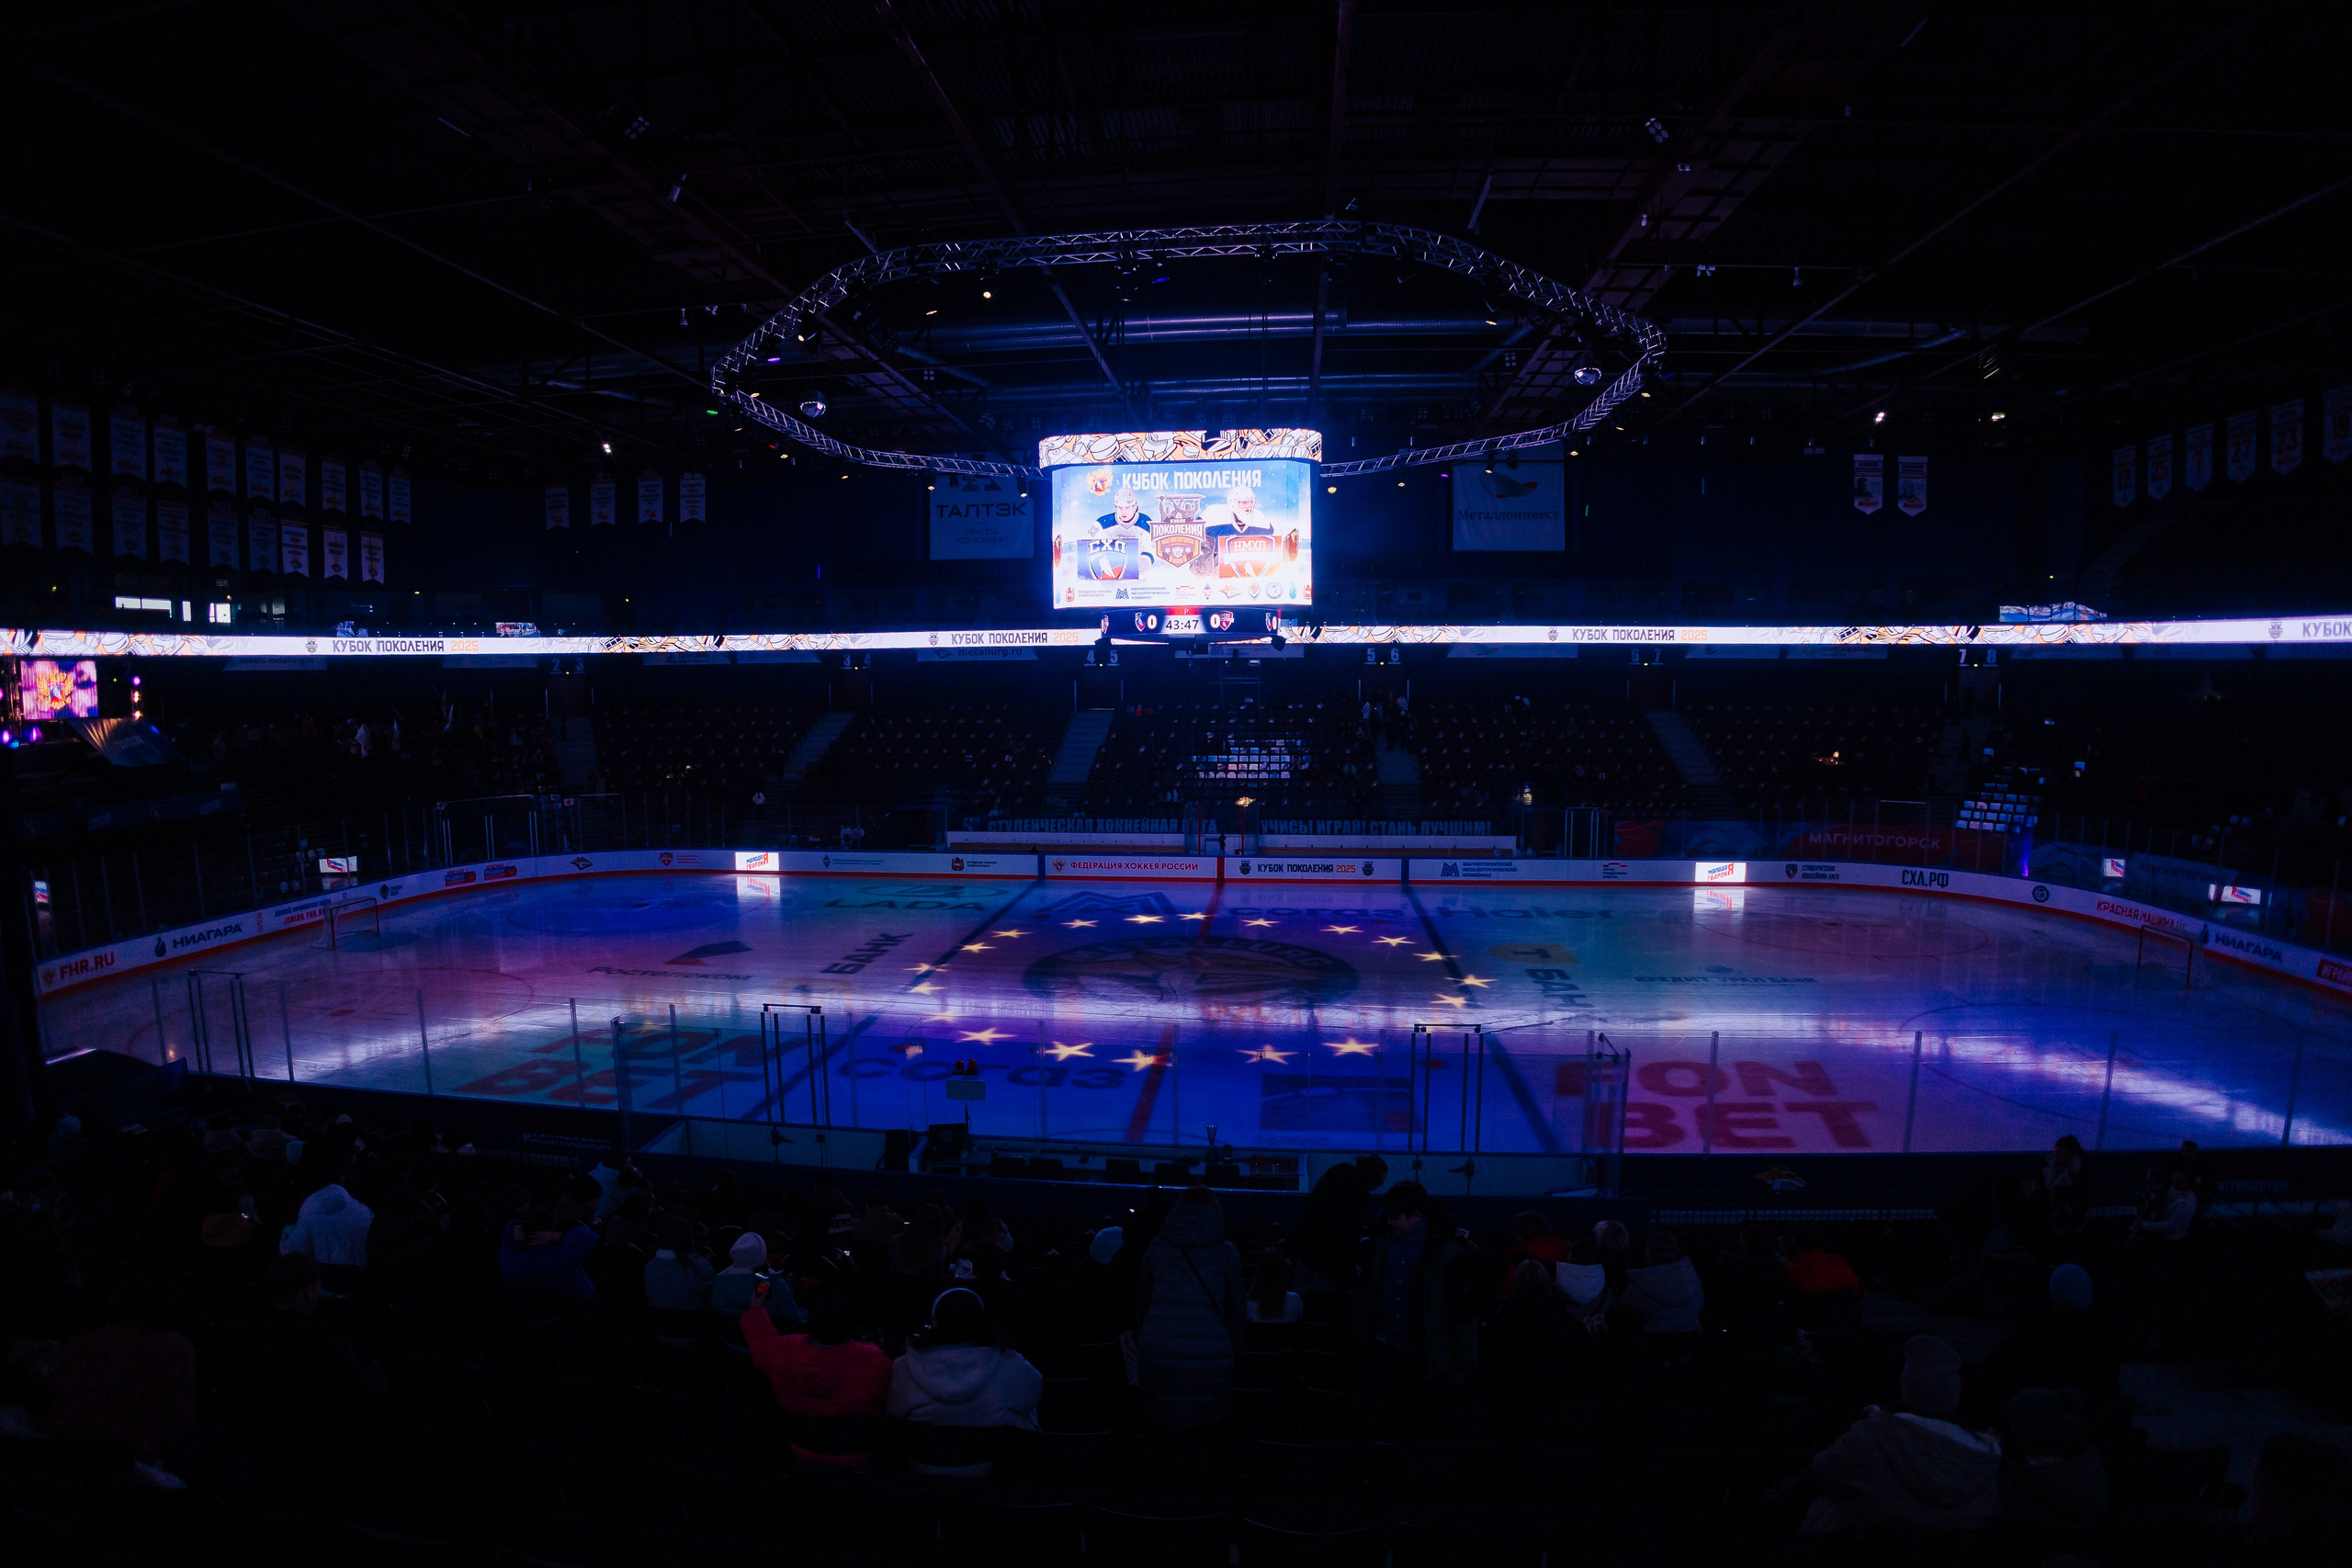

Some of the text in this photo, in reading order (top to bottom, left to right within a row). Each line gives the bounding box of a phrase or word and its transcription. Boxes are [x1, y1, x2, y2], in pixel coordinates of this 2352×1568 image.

[2231, 437, 2252, 465] 27
[2151, 460, 2168, 482] 25
[1122, 469, 1261, 491] КУБОК ПОКОЛЕНИЯ
[934, 502, 1029, 518] ТАЛТЭК
[1458, 510, 1559, 521] Металлоинвест
[1152, 523, 1204, 538] ПОКОЛЕНИЯ
[1234, 540, 1266, 551] НМХЛ
[1147, 615, 1158, 630] 0
[1165, 620, 1199, 630] 43:47
[1210, 614, 1221, 629] 0
[1572, 628, 1708, 641] КУБОК ПОКОЛЕНИЯ 2025
[2302, 621, 2352, 637] КУБОК
[951, 631, 1079, 645] КУБОК ПОКОЛЕНИЯ 2025
[332, 639, 479, 652] КУБОК ПОКОЛЕНИЯ 2025
[957, 646, 1023, 657] metallurg.ru
[842, 653, 852, 667] 3
[1086, 649, 1095, 663] 4
[1110, 649, 1118, 663] 5
[1366, 648, 1376, 662] 5
[1390, 648, 1400, 662] 6
[1654, 648, 1662, 662] 7
[1959, 649, 1967, 663] 7
[1986, 649, 1997, 663] 8
[551, 658, 560, 671] 2
[574, 657, 584, 671] 3
[988, 818, 1093, 833] СТУДЕНЧЕСКАЯ
[1096, 818, 1181, 833] ХОККЕЙНАЯ
[1261, 818, 1492, 836] УЧИСЬ! ИГРАЙ! СТАНЬ ЛУЧШИМ!
[1809, 832, 1941, 851] МАГНИТОГОРСК
[1070, 862, 1199, 871] ФЕДЕРАЦИЯ ХОККЕЯ РОССИИ
[1257, 863, 1356, 873] КУБОК ПОКОЛЕНИЯ 2025
[1902, 869, 1950, 888] СХЛ.РФ
[823, 898, 988, 912] LADA
[1228, 906, 1404, 919] согаз
[1439, 906, 1616, 919] Haier
[2097, 900, 2175, 927] КРАСНАЯ МАШИНА
[172, 922, 243, 950] НИАГАРА
[821, 932, 915, 975] БАНК
[2214, 931, 2283, 962] НИАГАРА
[59, 952, 116, 980] FHR.RU
[586, 966, 752, 982] Ростелеком
[837, 1052, 1125, 1090] согаз
[1555, 1059, 1838, 1098] FON
[1585, 1101, 1878, 1148] BET
